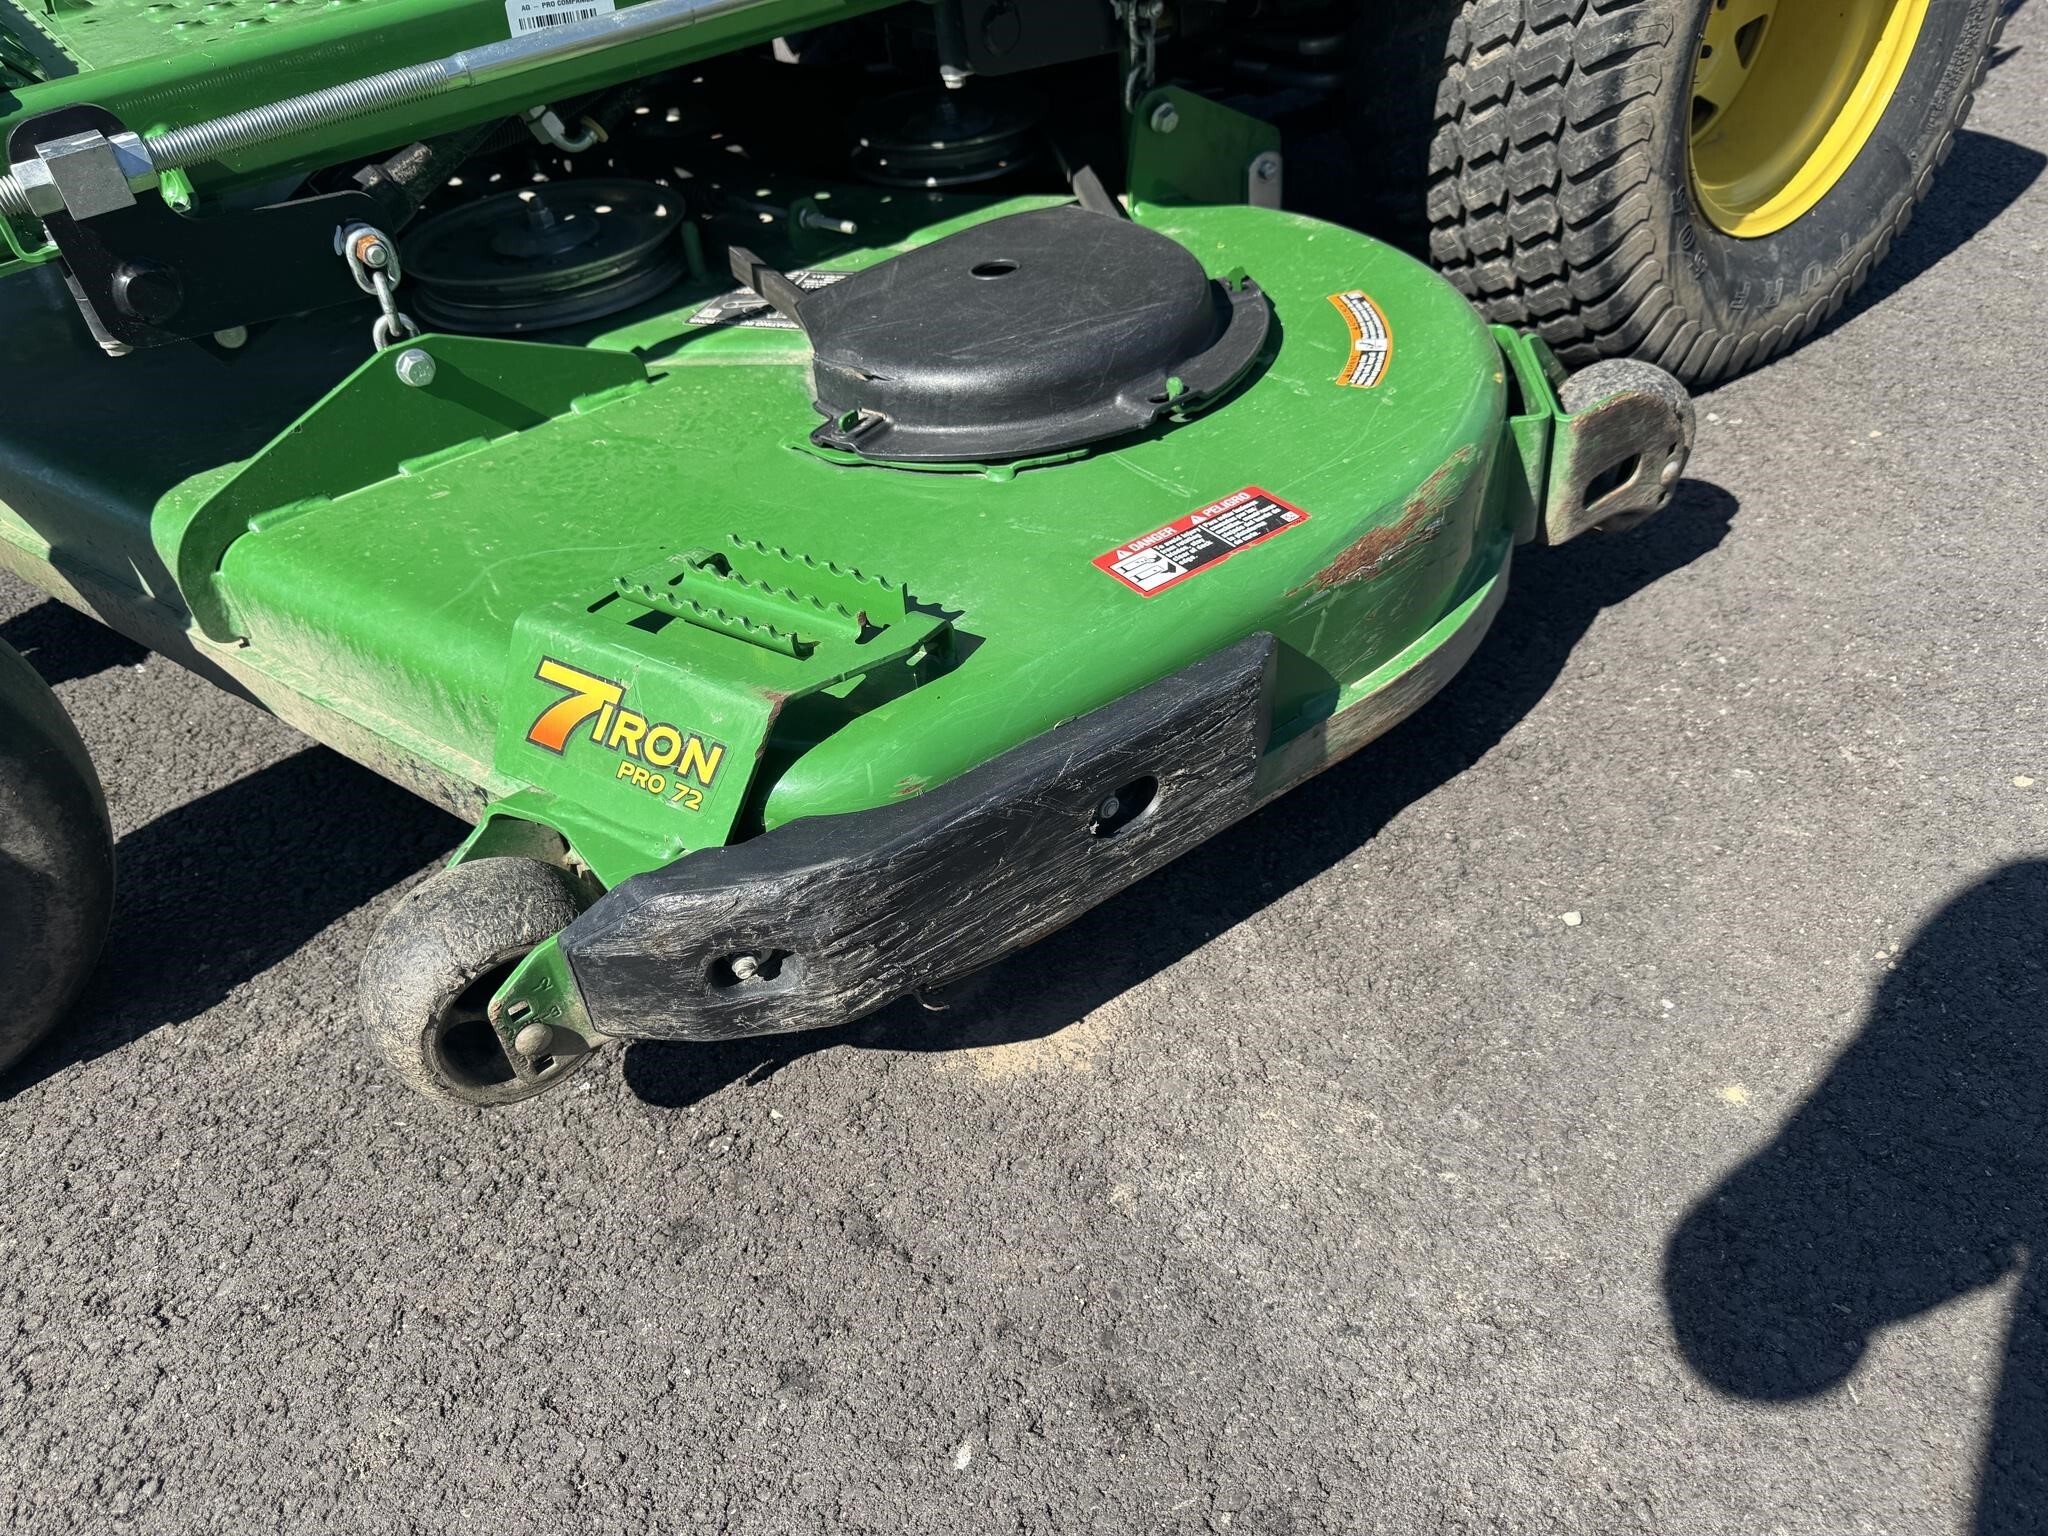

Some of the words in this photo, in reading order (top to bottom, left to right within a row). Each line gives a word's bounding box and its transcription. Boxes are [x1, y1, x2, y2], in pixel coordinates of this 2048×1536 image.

[521, 4, 531, 12] AG
[541, 1, 556, 9] PRO
[1202, 492, 1251, 517] PELIGRO
[1128, 527, 1178, 552] DANGER
[526, 655, 626, 757] 7
[590, 699, 727, 788] IRON
[616, 760, 667, 795] PRO
[671, 782, 704, 813] 72
